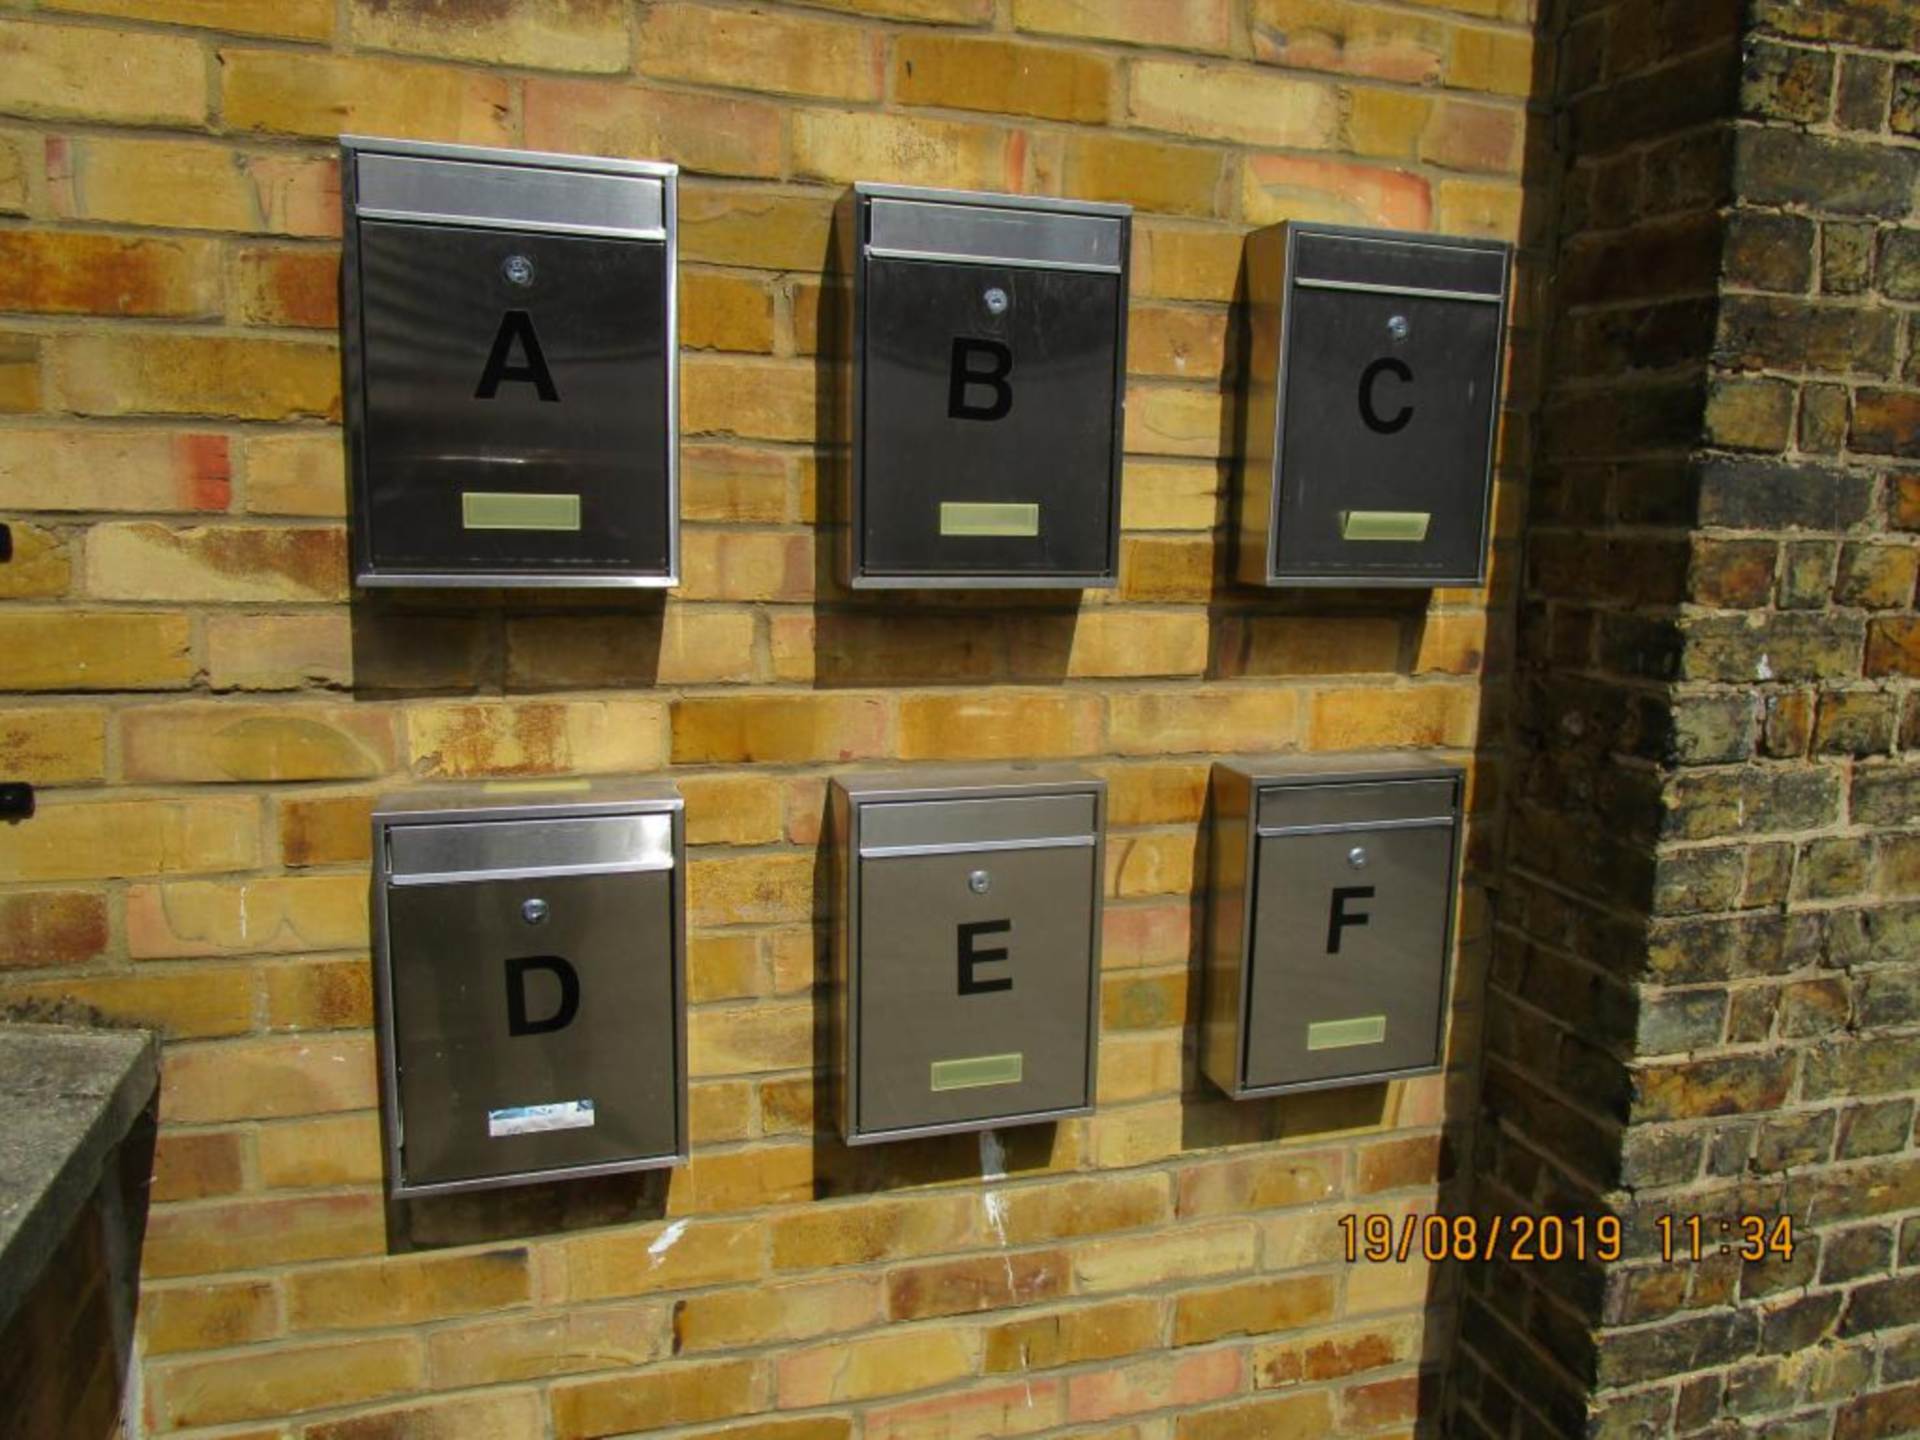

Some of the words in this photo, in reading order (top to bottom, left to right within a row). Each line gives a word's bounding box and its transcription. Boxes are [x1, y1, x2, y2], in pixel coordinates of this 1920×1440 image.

[474, 310, 560, 402] A
[949, 338, 1013, 421] B
[1358, 358, 1413, 434] C
[957, 919, 1012, 996] E
[1326, 886, 1375, 954] F
[505, 956, 579, 1036] D
